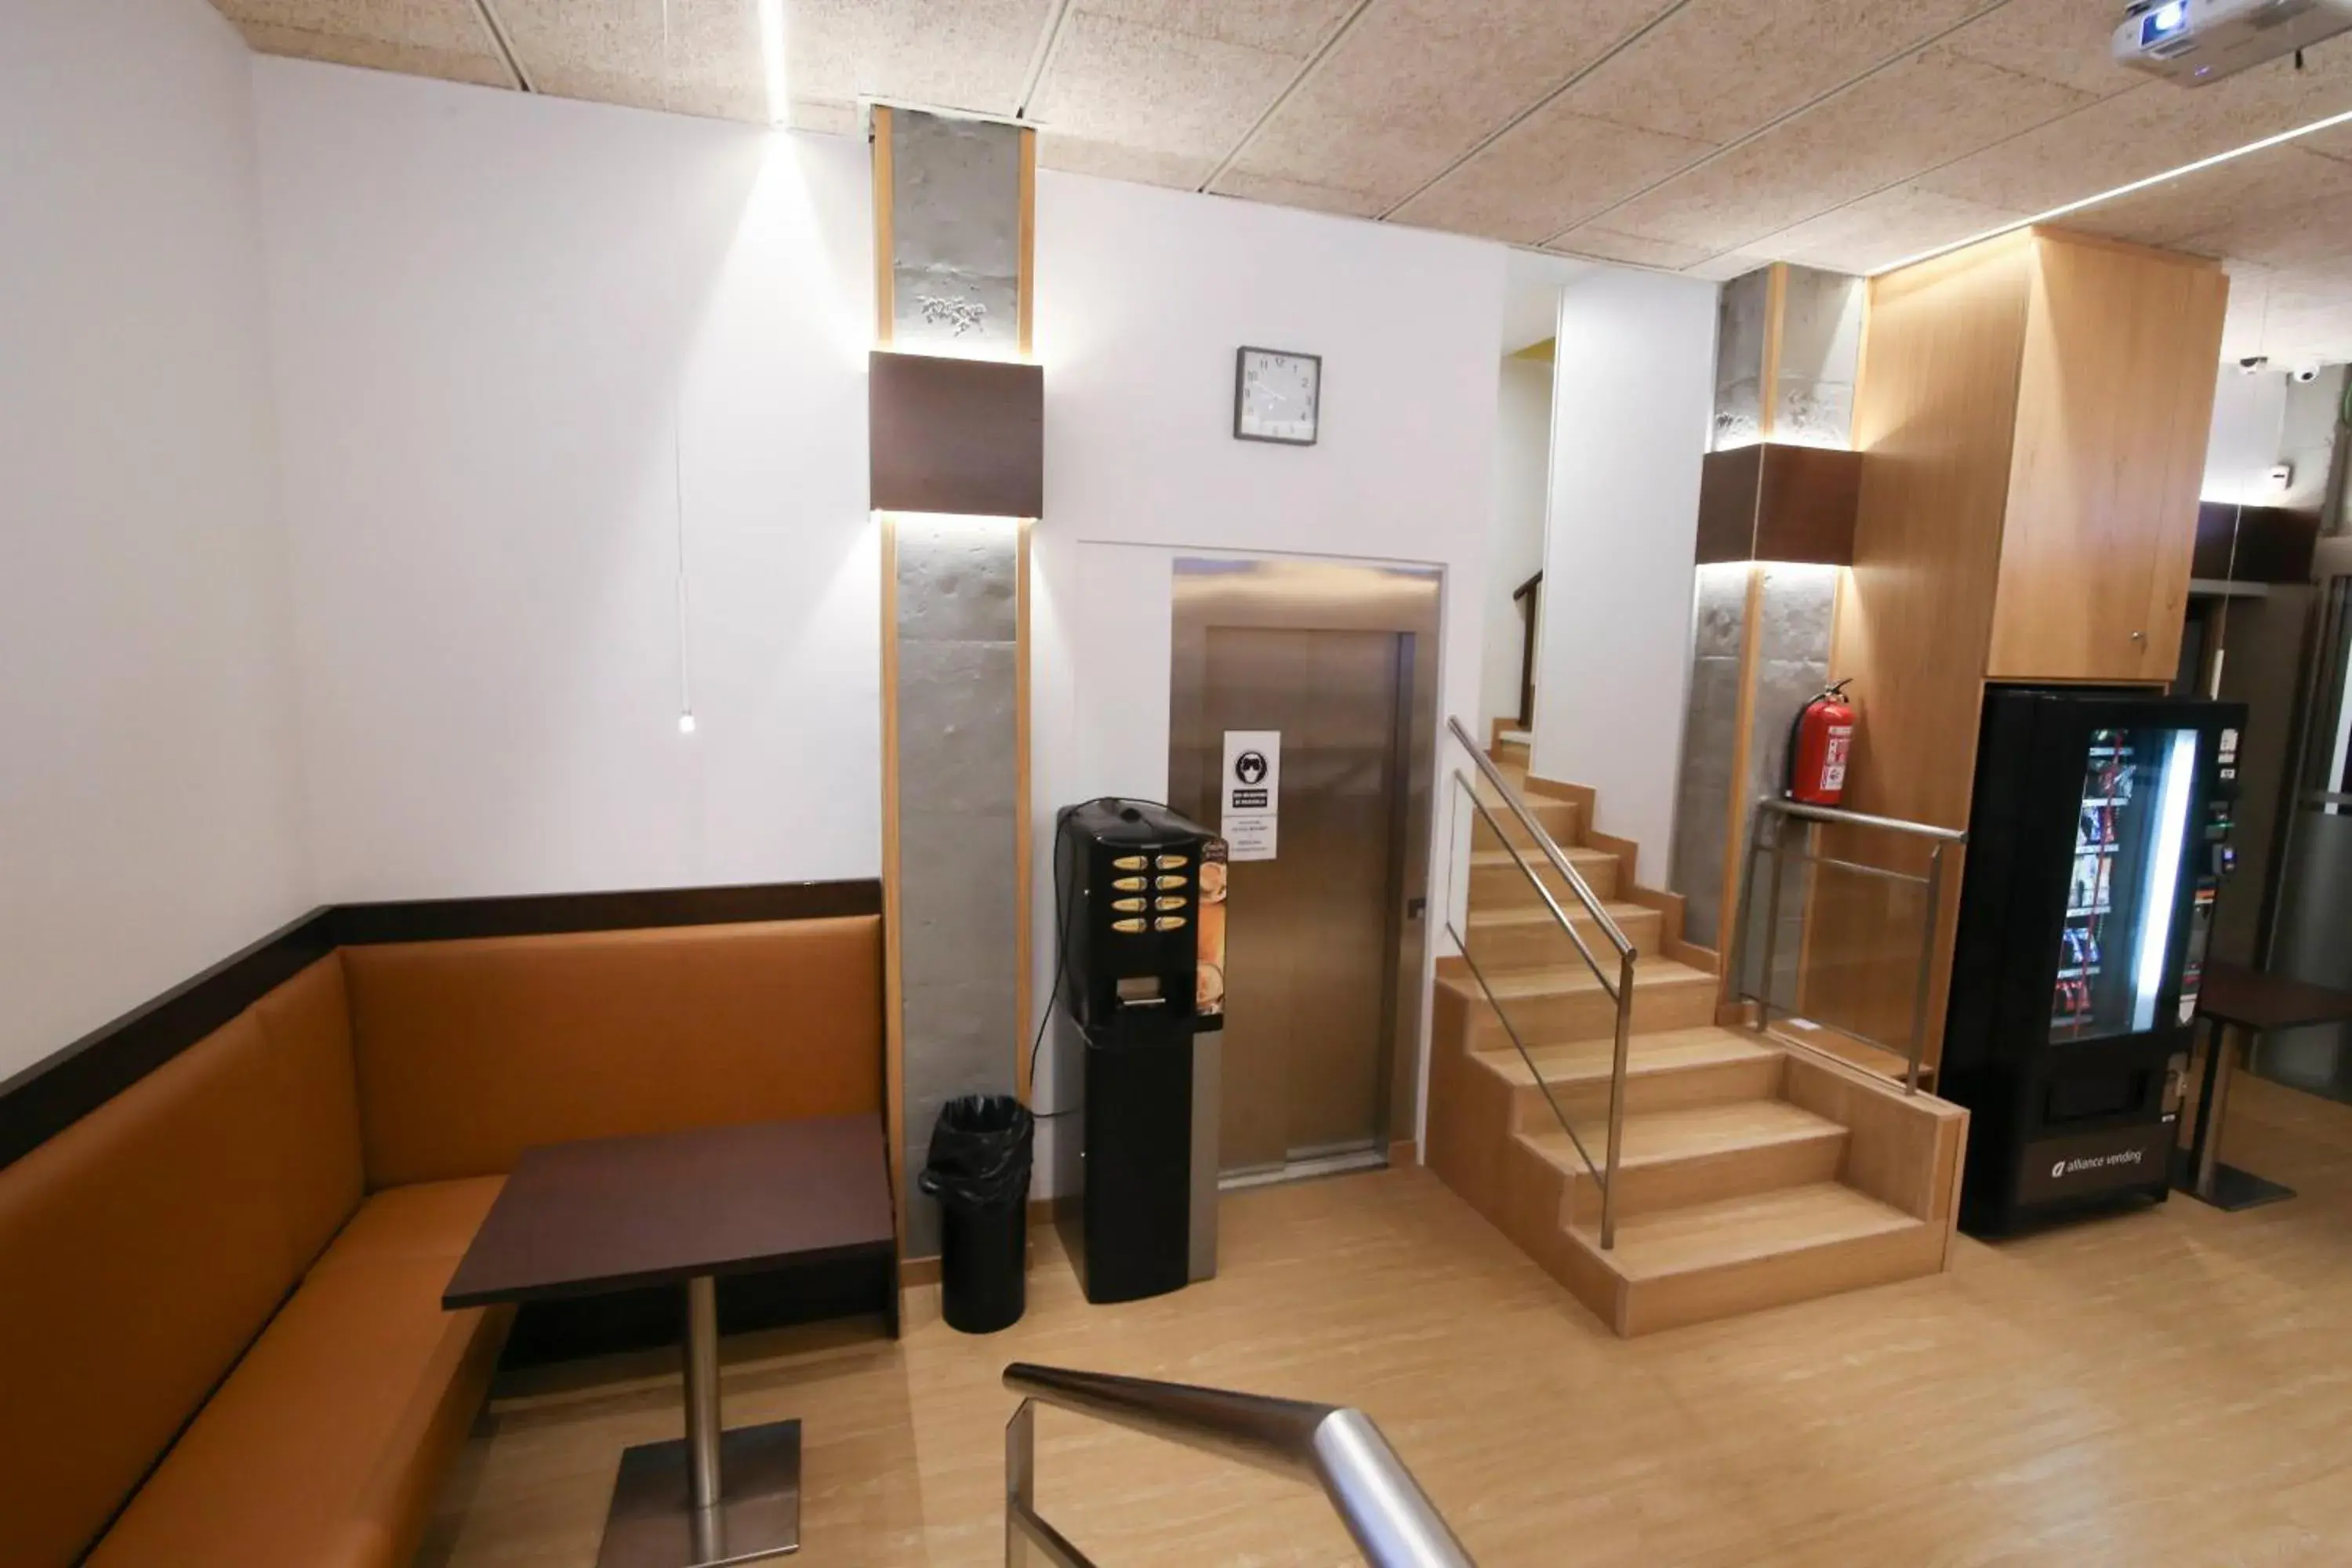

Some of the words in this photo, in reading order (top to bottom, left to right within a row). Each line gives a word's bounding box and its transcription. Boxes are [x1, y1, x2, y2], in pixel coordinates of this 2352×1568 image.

[1261, 358, 1268, 369] 11
[1275, 357, 1285, 367] 12
[1301, 377, 1309, 388] 2
[2067, 1157, 2104, 1173] alliance
[2106, 1150, 2143, 1165] vending
